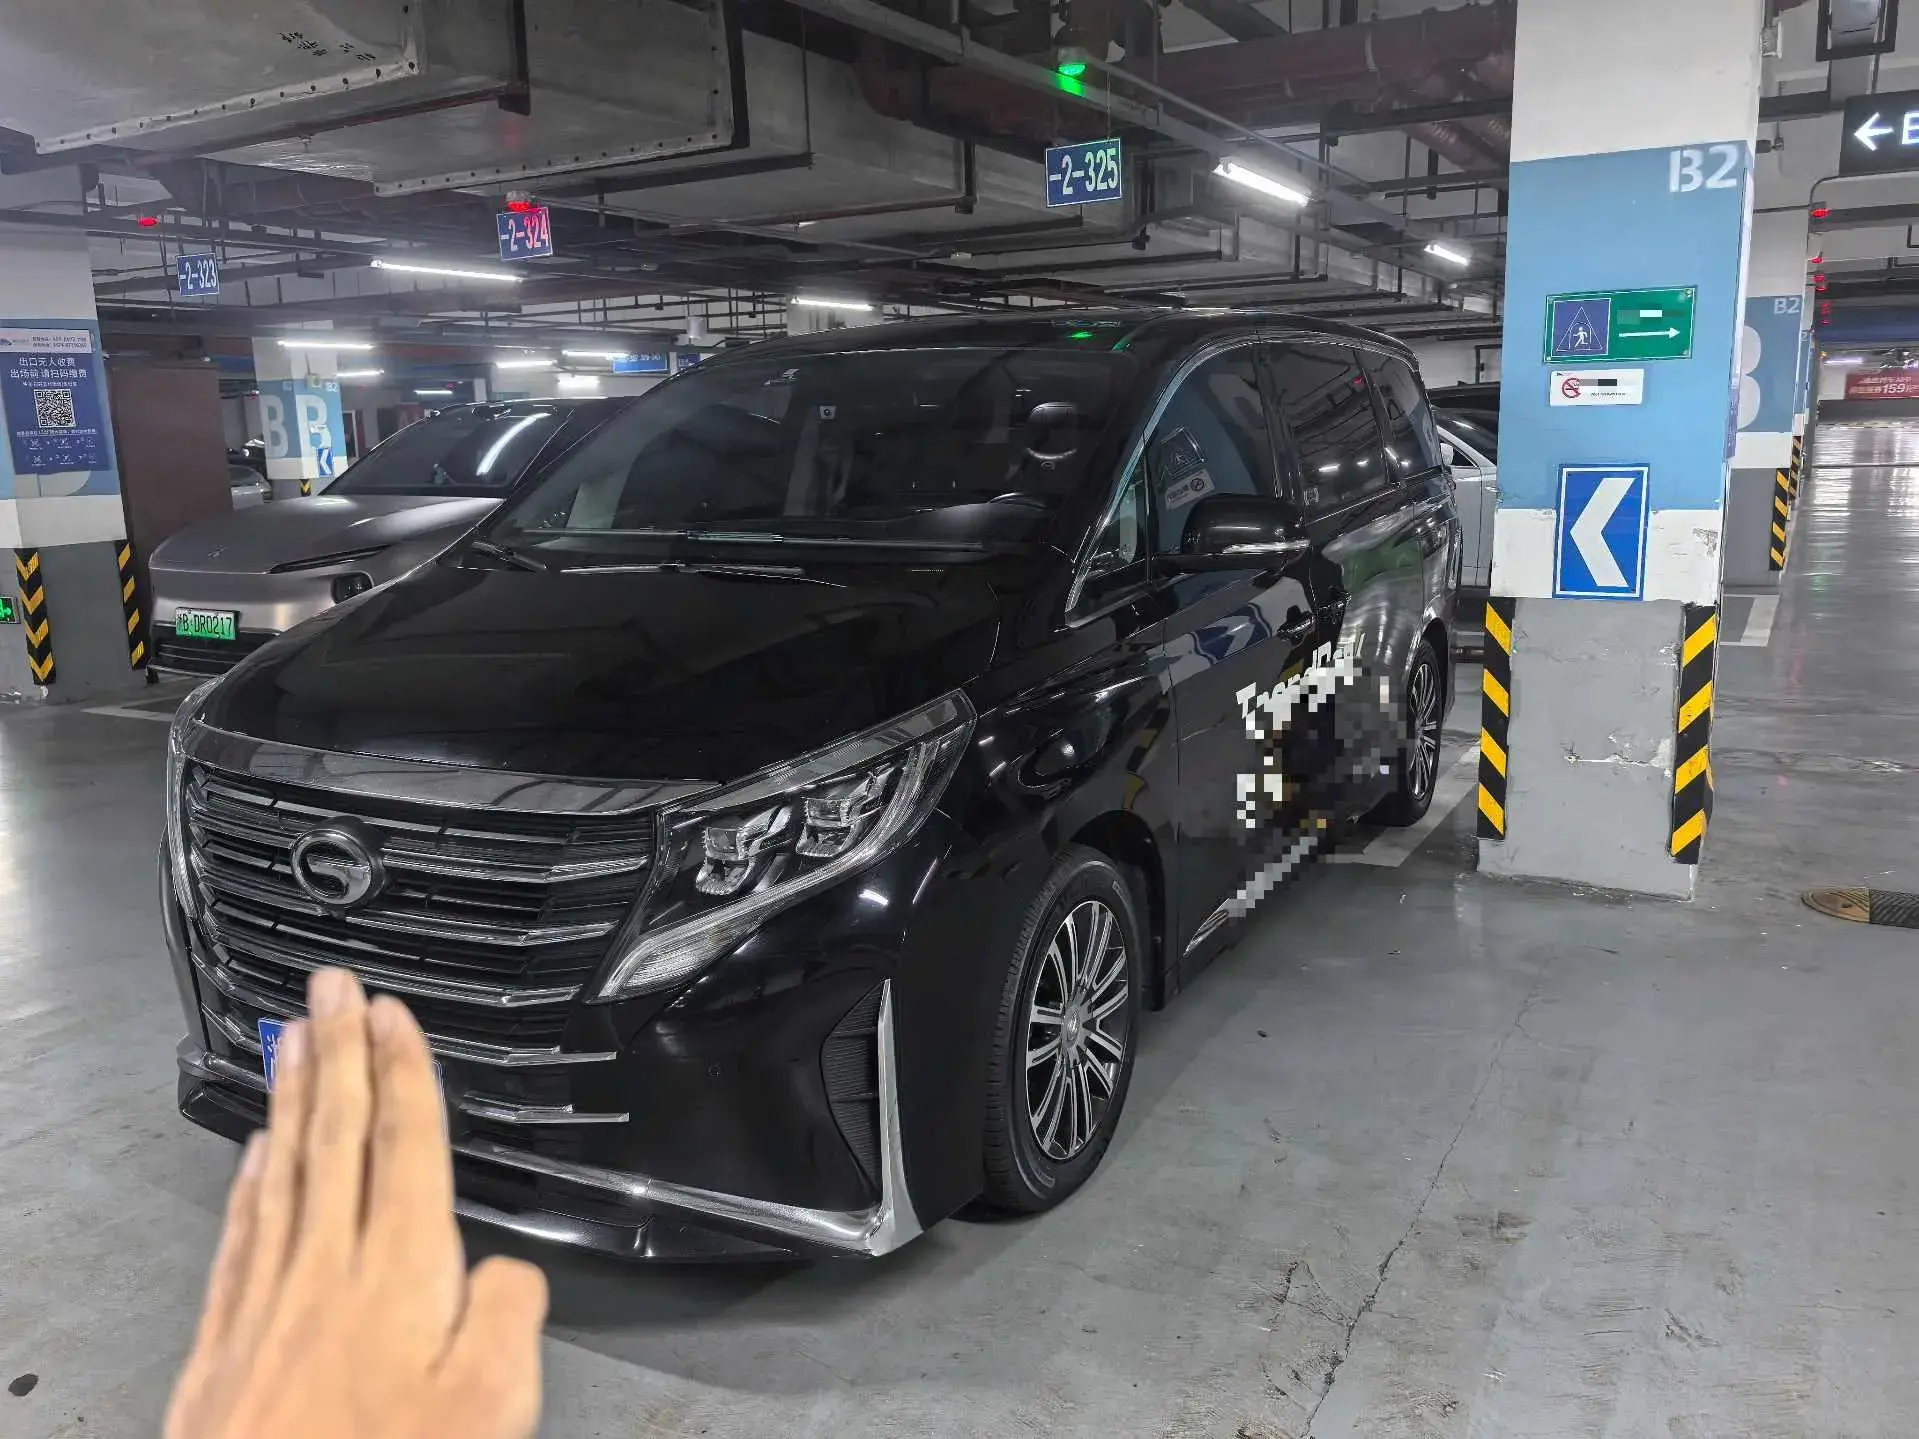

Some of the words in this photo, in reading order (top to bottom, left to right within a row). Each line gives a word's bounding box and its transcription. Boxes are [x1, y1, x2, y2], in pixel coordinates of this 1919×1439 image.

[1049, 147, 1118, 194] -2-325
[1669, 144, 1738, 192] B2
[500, 213, 549, 252] -2-324
[180, 258, 216, 289] -2-323
[1774, 298, 1800, 314] B2
[260, 394, 289, 458] B
